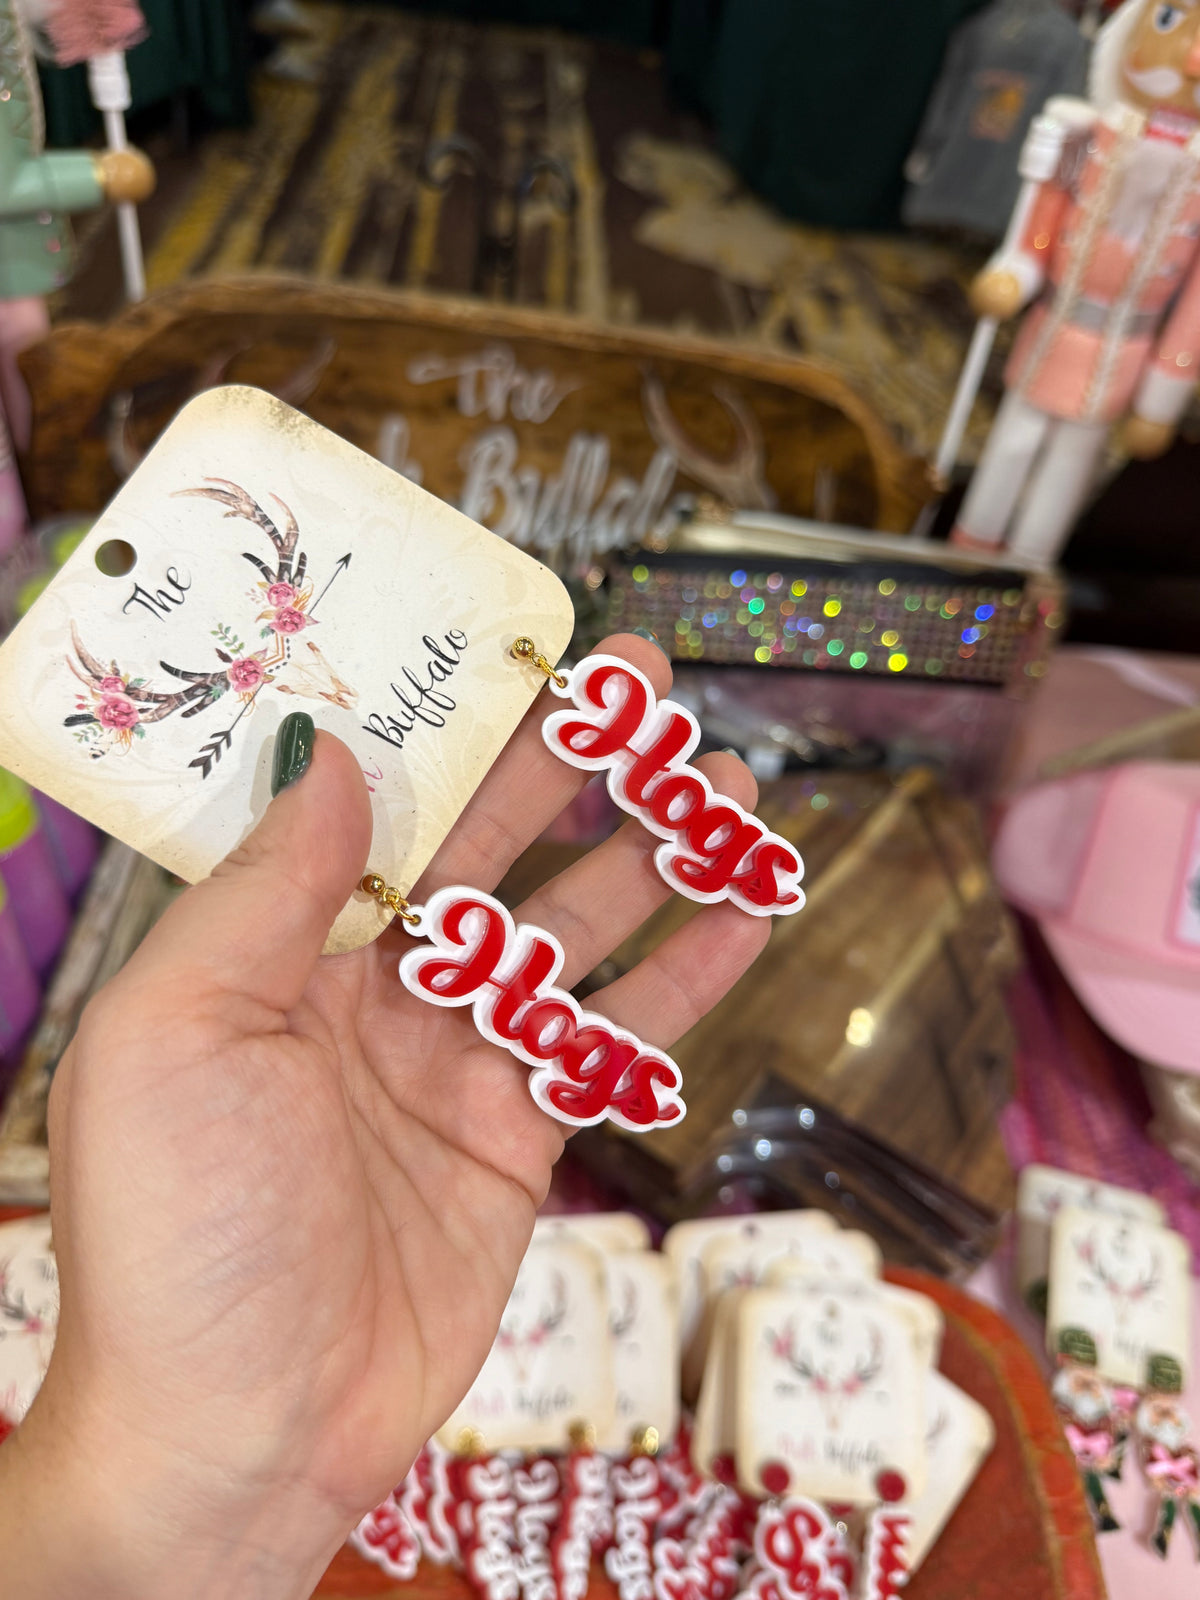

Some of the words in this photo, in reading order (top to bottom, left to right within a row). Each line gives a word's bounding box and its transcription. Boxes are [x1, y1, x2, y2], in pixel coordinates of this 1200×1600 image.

[122, 566, 192, 622] The
[362, 628, 468, 749] Buffalo
[558, 665, 800, 907] Hogs
[418, 898, 682, 1126] Hogs
